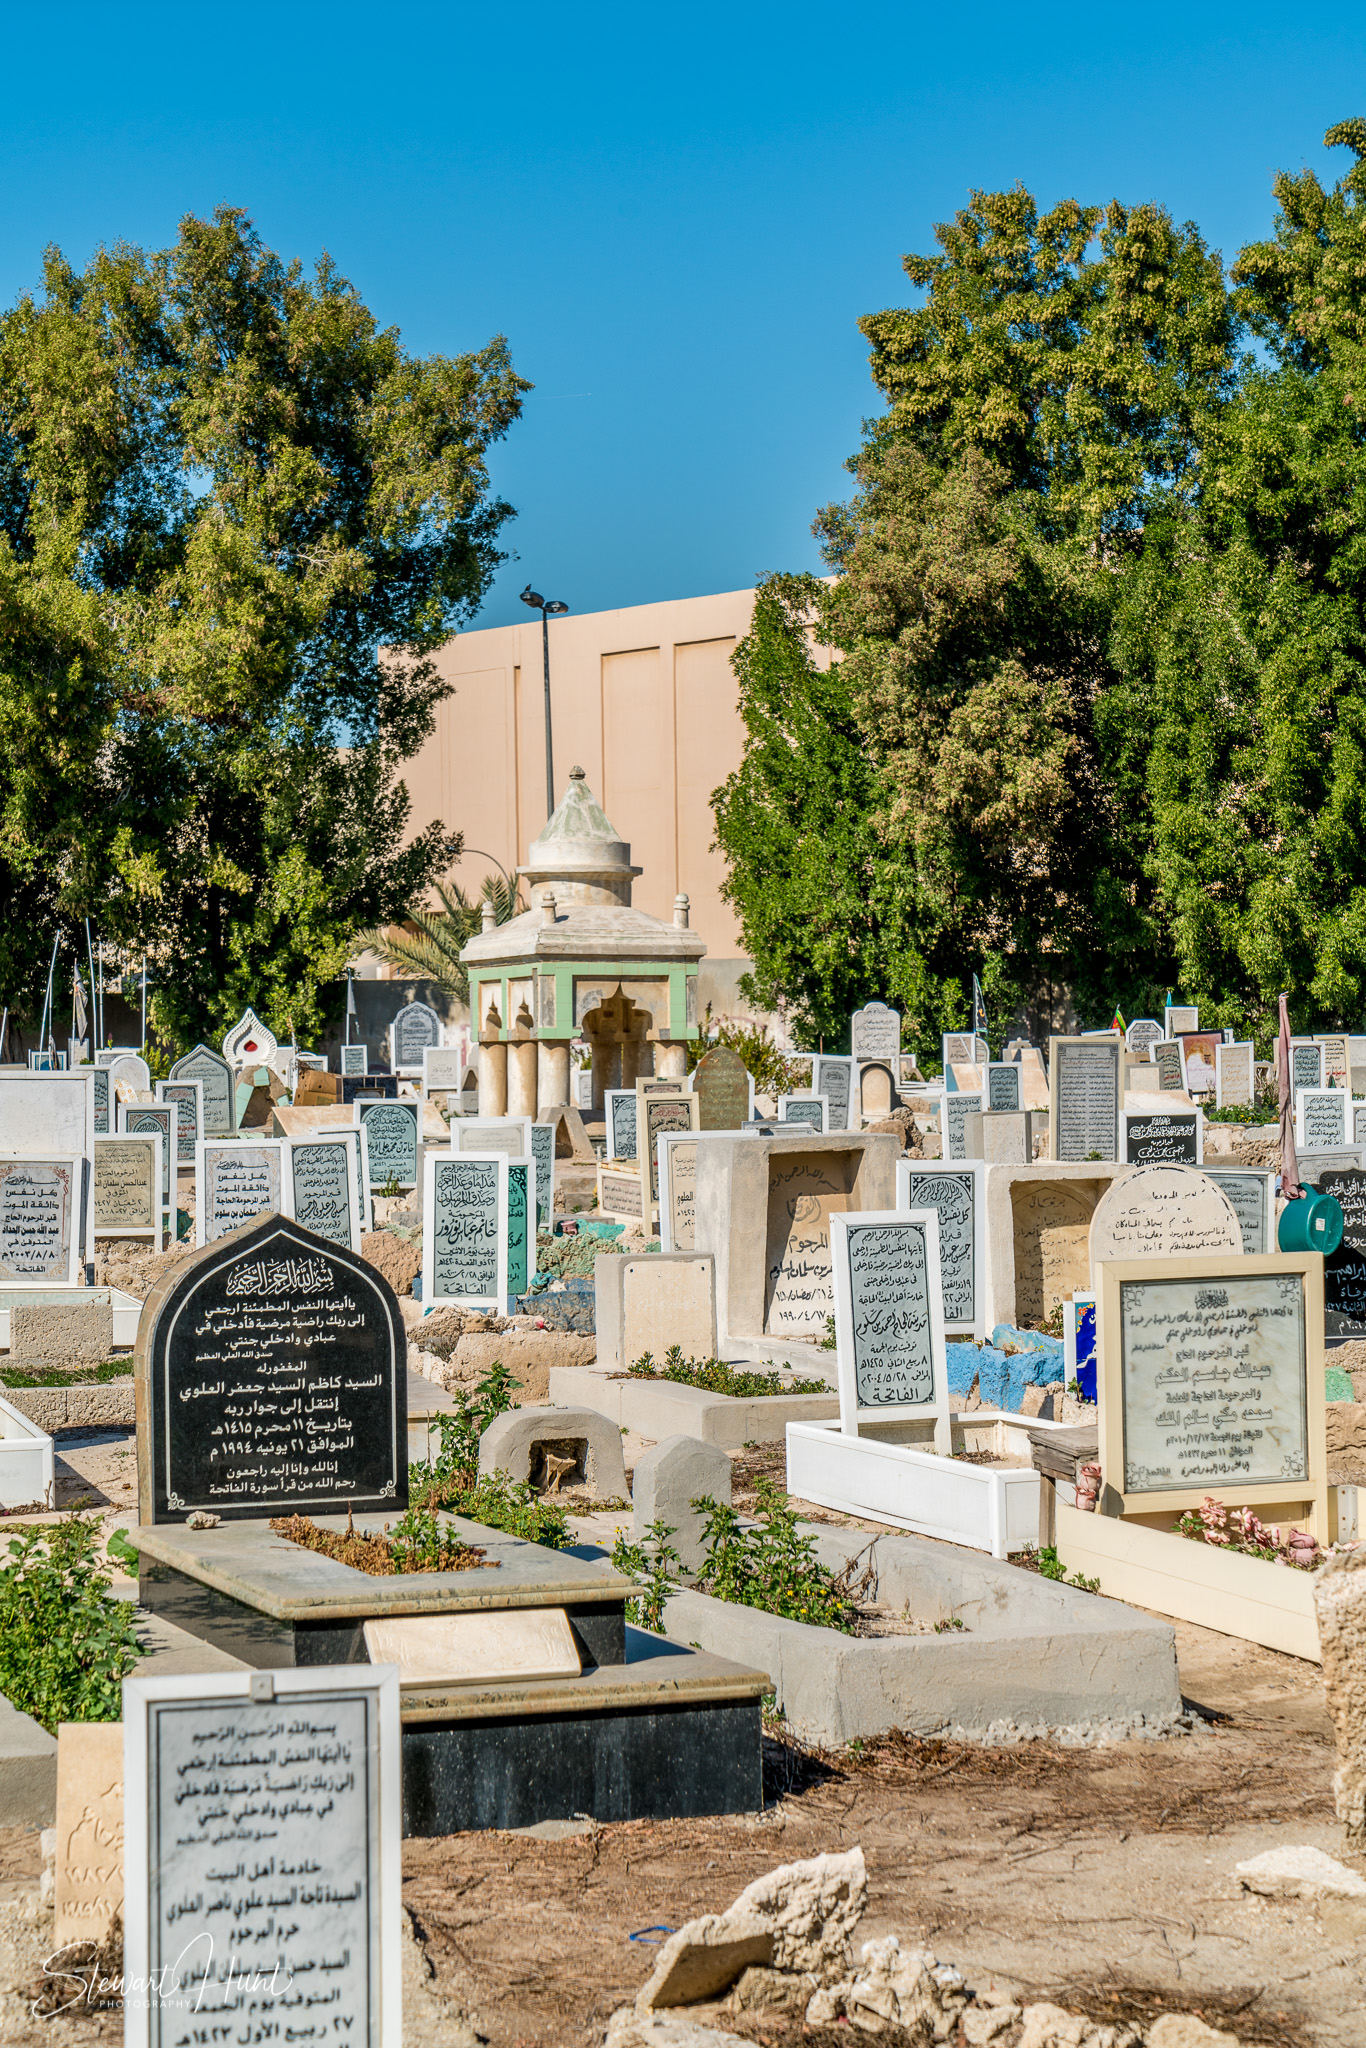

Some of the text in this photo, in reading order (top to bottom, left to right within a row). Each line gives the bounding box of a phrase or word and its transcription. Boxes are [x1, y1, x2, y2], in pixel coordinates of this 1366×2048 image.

[205, 1303, 240, 1318] ارجعي
[242, 1301, 290, 1315] المطمئنة
[291, 1299, 324, 1314] النفس
[195, 1313, 365, 1336] إلى ربك راضية مرضية فأدخلي في
[260, 1333, 302, 1350] وادخلي
[303, 1334, 337, 1348] عبادي
[241, 1351, 254, 1359] الله
[179, 1374, 382, 1402] السيد كاظم السيد جعفر العلوي
[224, 1396, 339, 1417] إنتقل إلى جوار ربه
[254, 1421, 291, 1440] محرم
[292, 1418, 304, 1431] ١١
[210, 1435, 354, 1462] الموافق ٢١ يونيه ١٩٩٤ م
[226, 1464, 268, 1479] راجعون
[270, 1463, 290, 1476] إليه
[290, 1462, 310, 1476] وإنا
[209, 1477, 356, 1495] رحم الله من قرأ سورة الفاتحة
